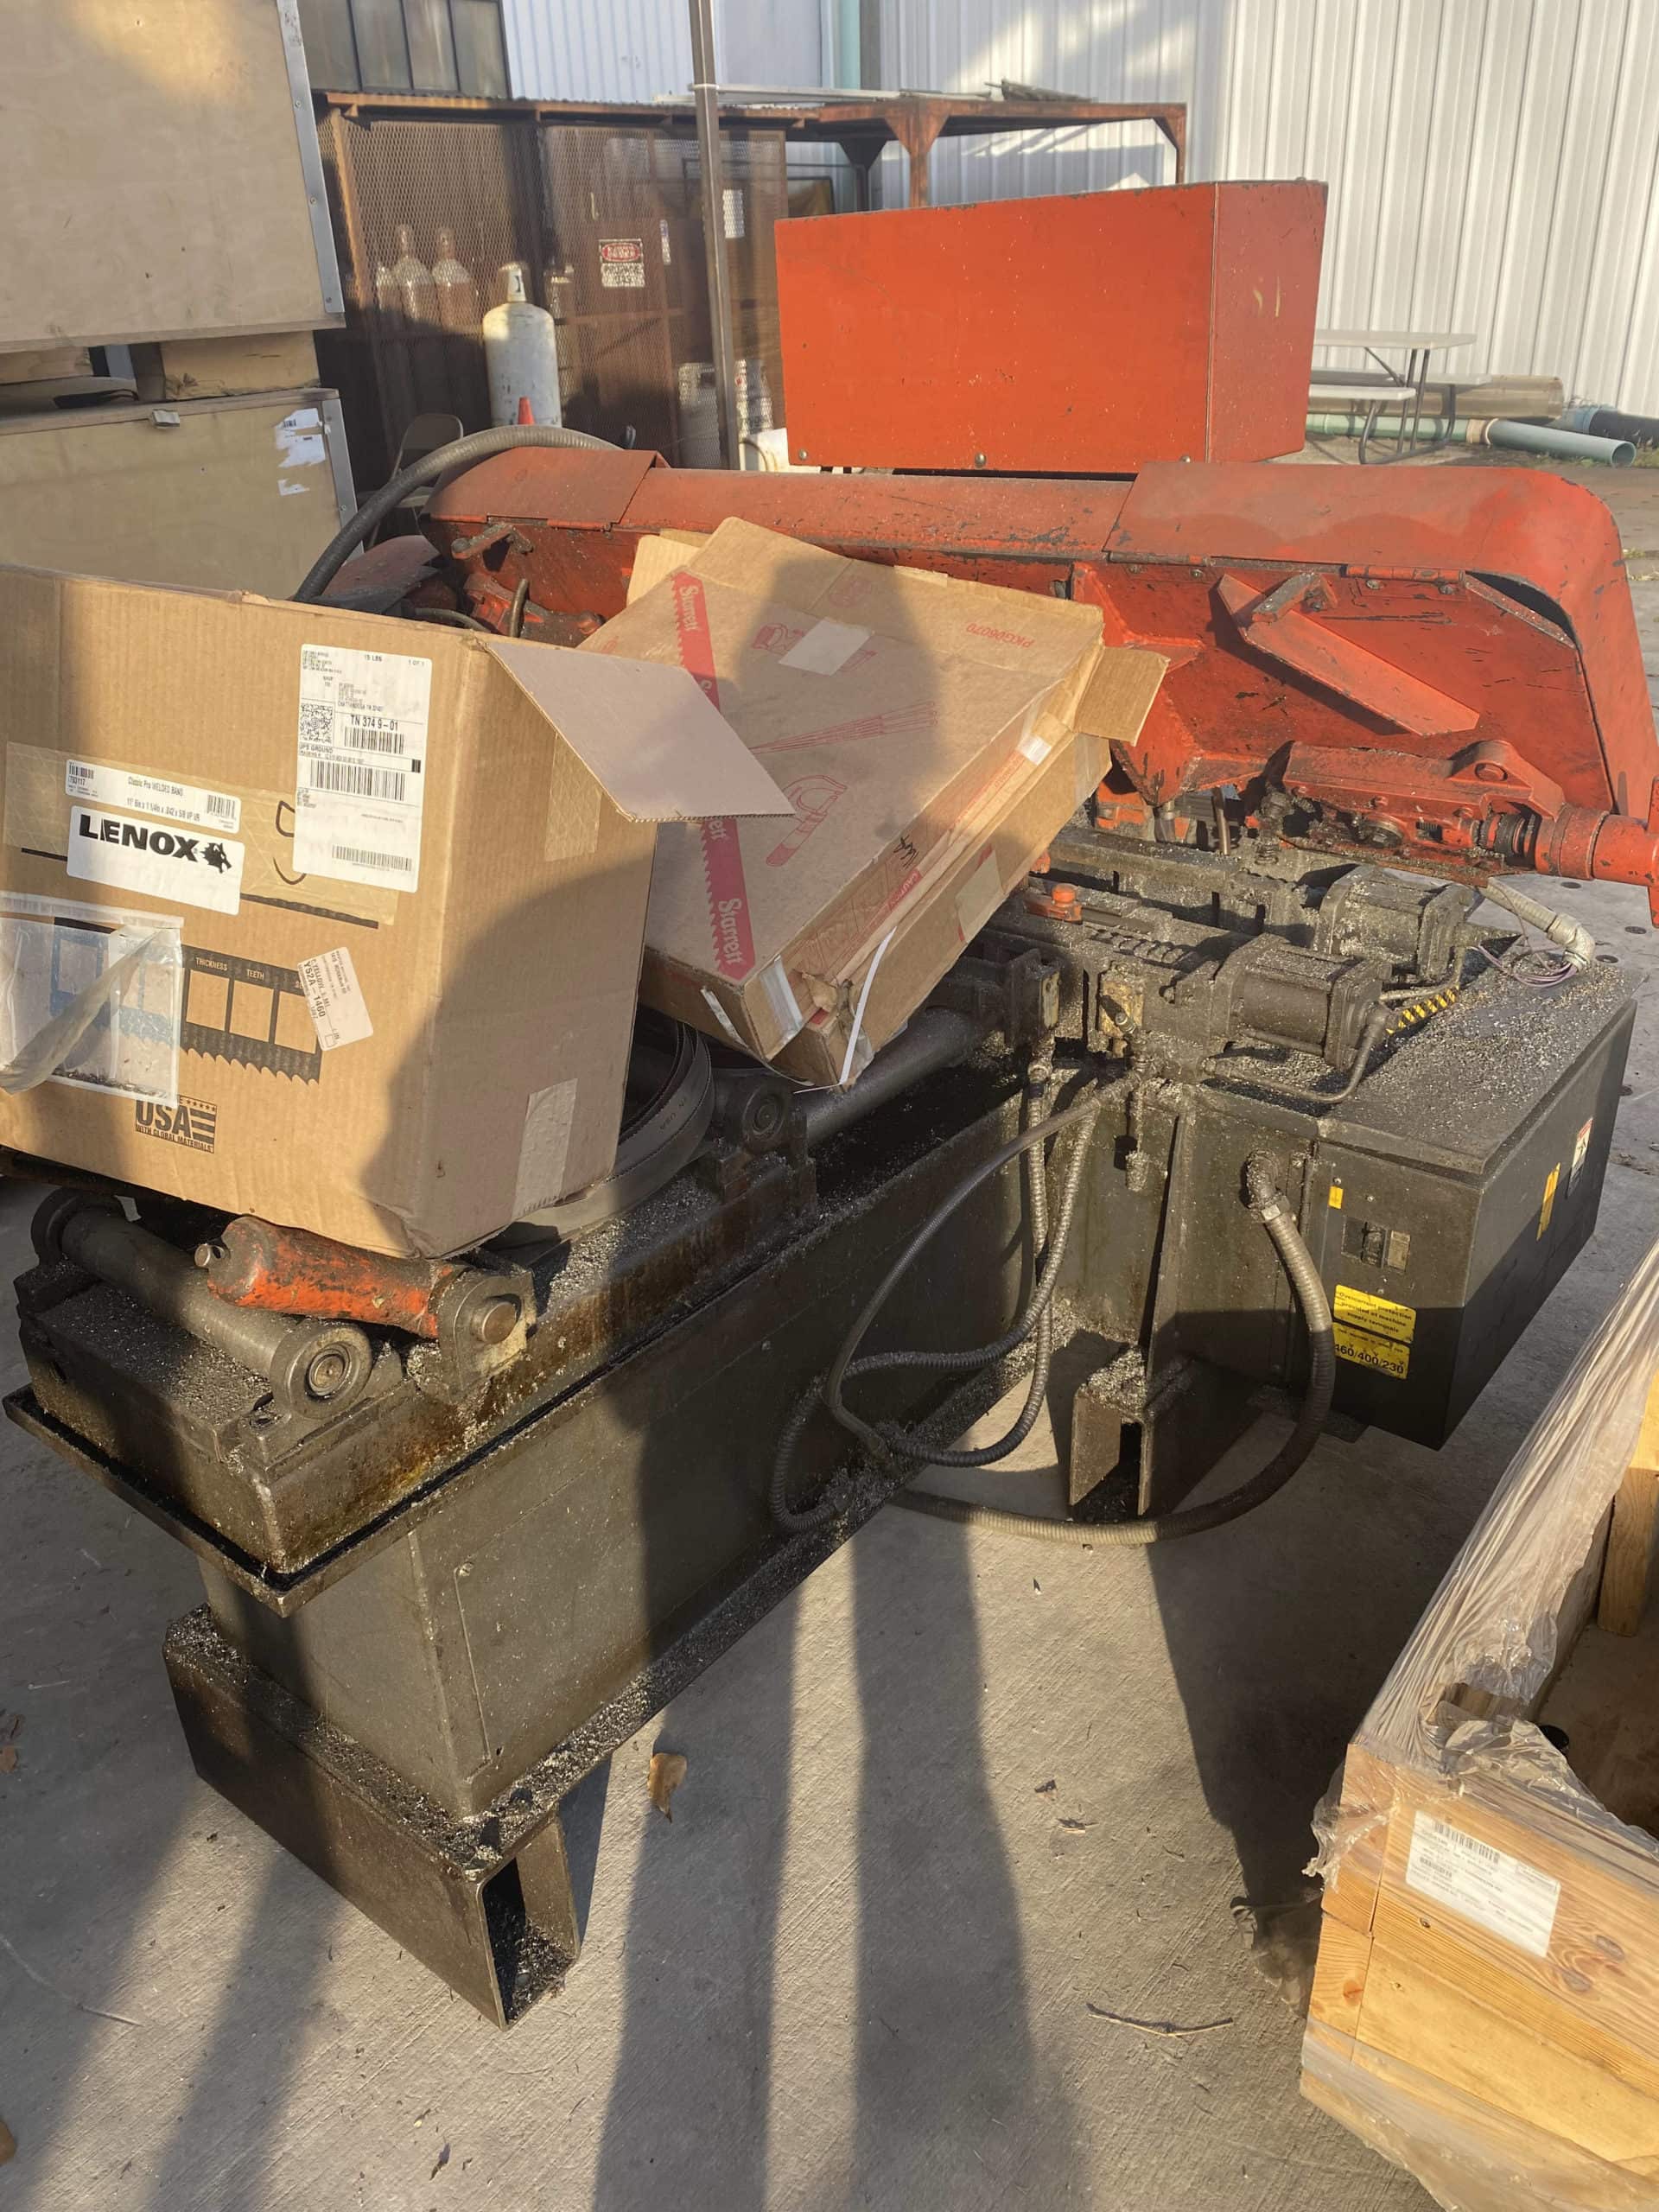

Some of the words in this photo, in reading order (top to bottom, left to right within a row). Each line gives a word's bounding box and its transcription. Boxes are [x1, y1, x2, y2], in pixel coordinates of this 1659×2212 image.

[351, 715, 360, 727] TN
[363, 717, 375, 728] 374
[79, 814, 200, 862] LENOX
[718, 898, 743, 965] Starrett
[196, 957, 228, 971] THICKNESS
[247, 969, 264, 980] TEETH
[136, 1100, 192, 1139] USA
[153, 1128, 175, 1141] GLOBAL
[178, 1135, 212, 1152] MATERIALS
[1377, 1306, 1412, 1321] protection
[1379, 1314, 1407, 1327] machine
